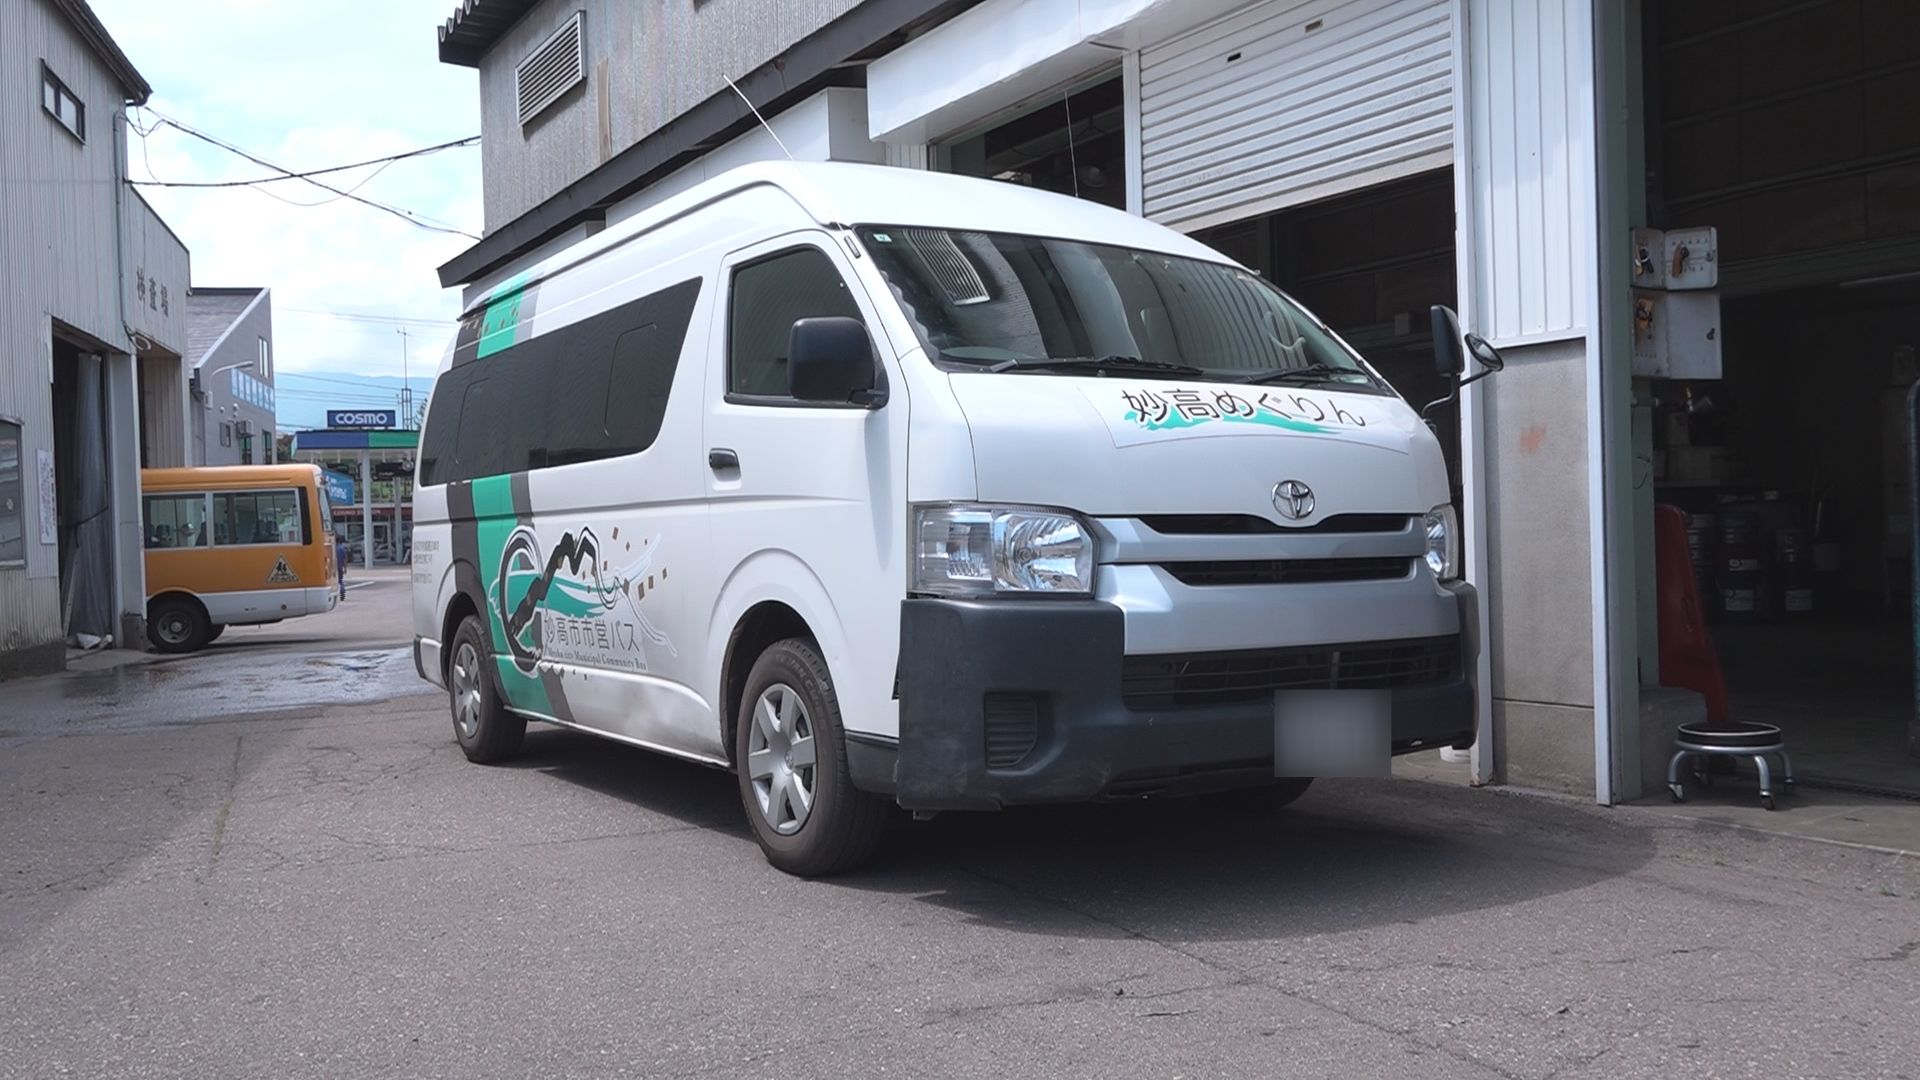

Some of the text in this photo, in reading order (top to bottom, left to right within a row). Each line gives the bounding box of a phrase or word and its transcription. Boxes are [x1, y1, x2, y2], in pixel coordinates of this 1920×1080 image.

[335, 413, 387, 425] COSMO
[1122, 389, 1366, 427] 妙高めぐりん
[544, 613, 640, 652] 妙高市市営バス
